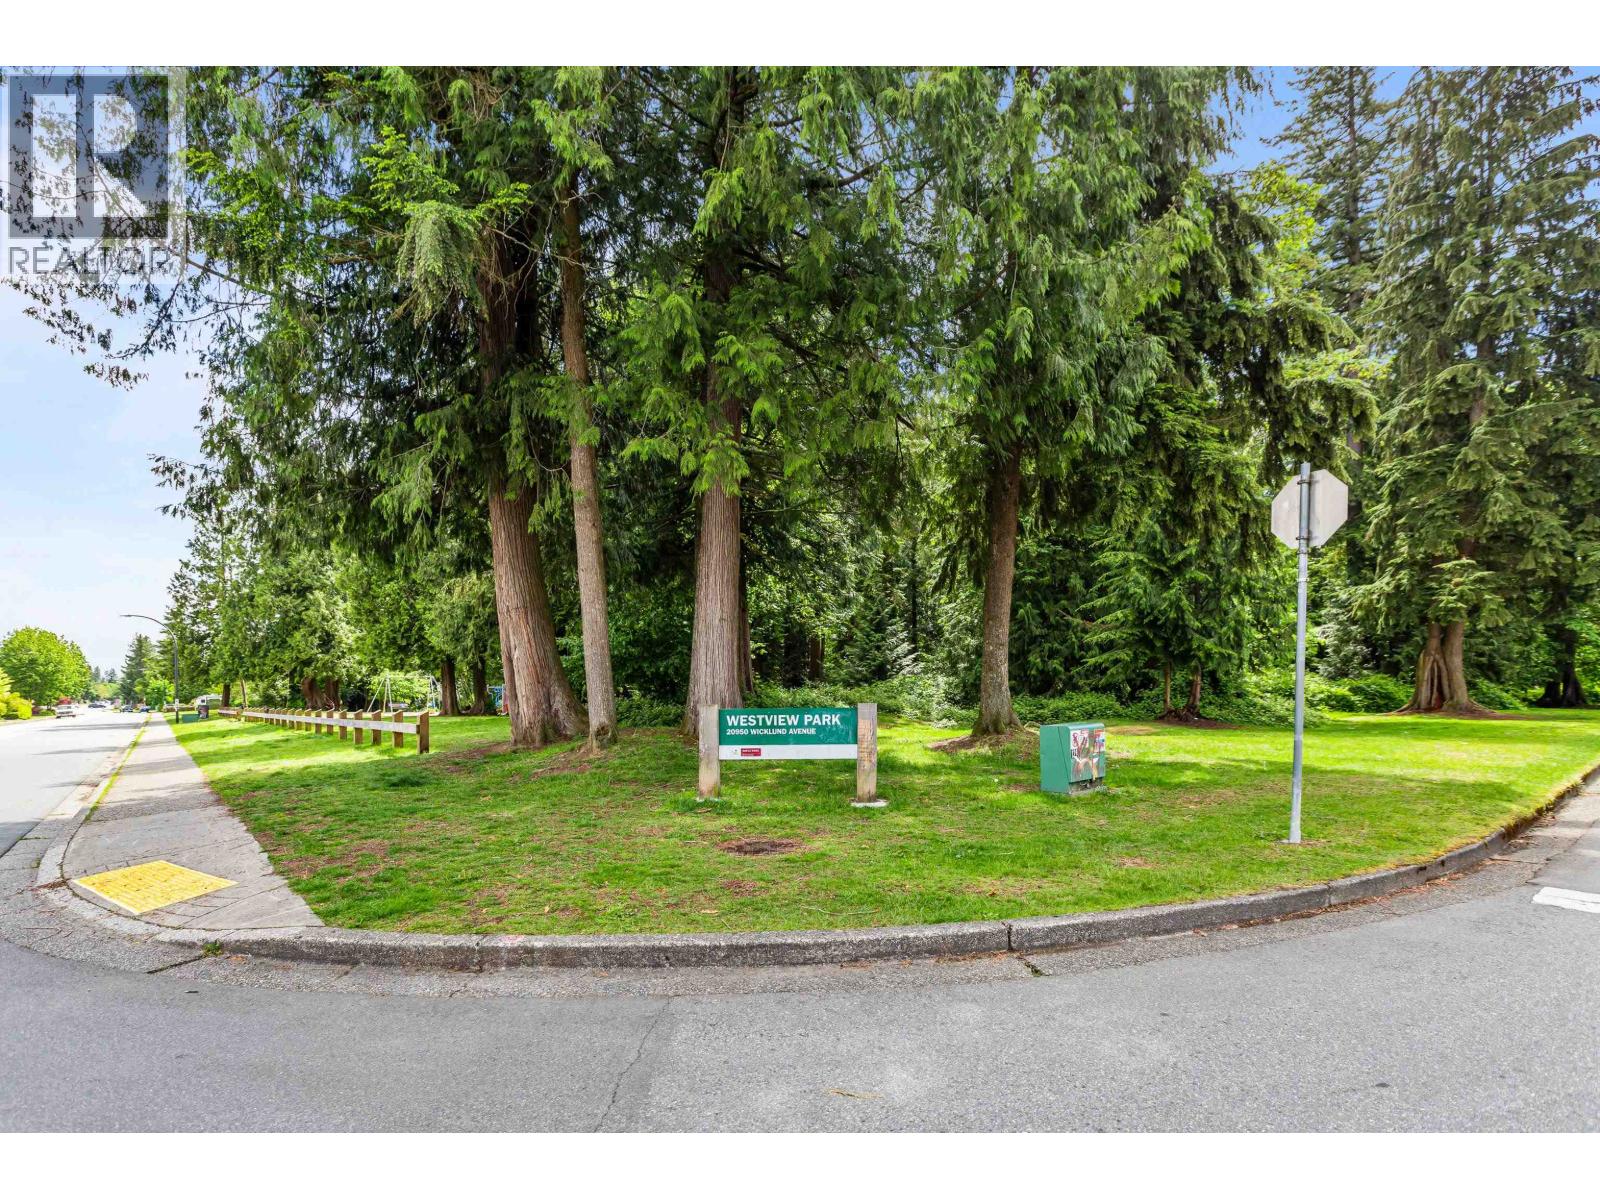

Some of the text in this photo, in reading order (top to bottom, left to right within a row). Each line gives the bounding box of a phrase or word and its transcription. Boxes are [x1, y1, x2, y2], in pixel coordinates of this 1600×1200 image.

[726, 713, 841, 727] WESTVIEW PARK
[726, 728, 749, 736] 20950
